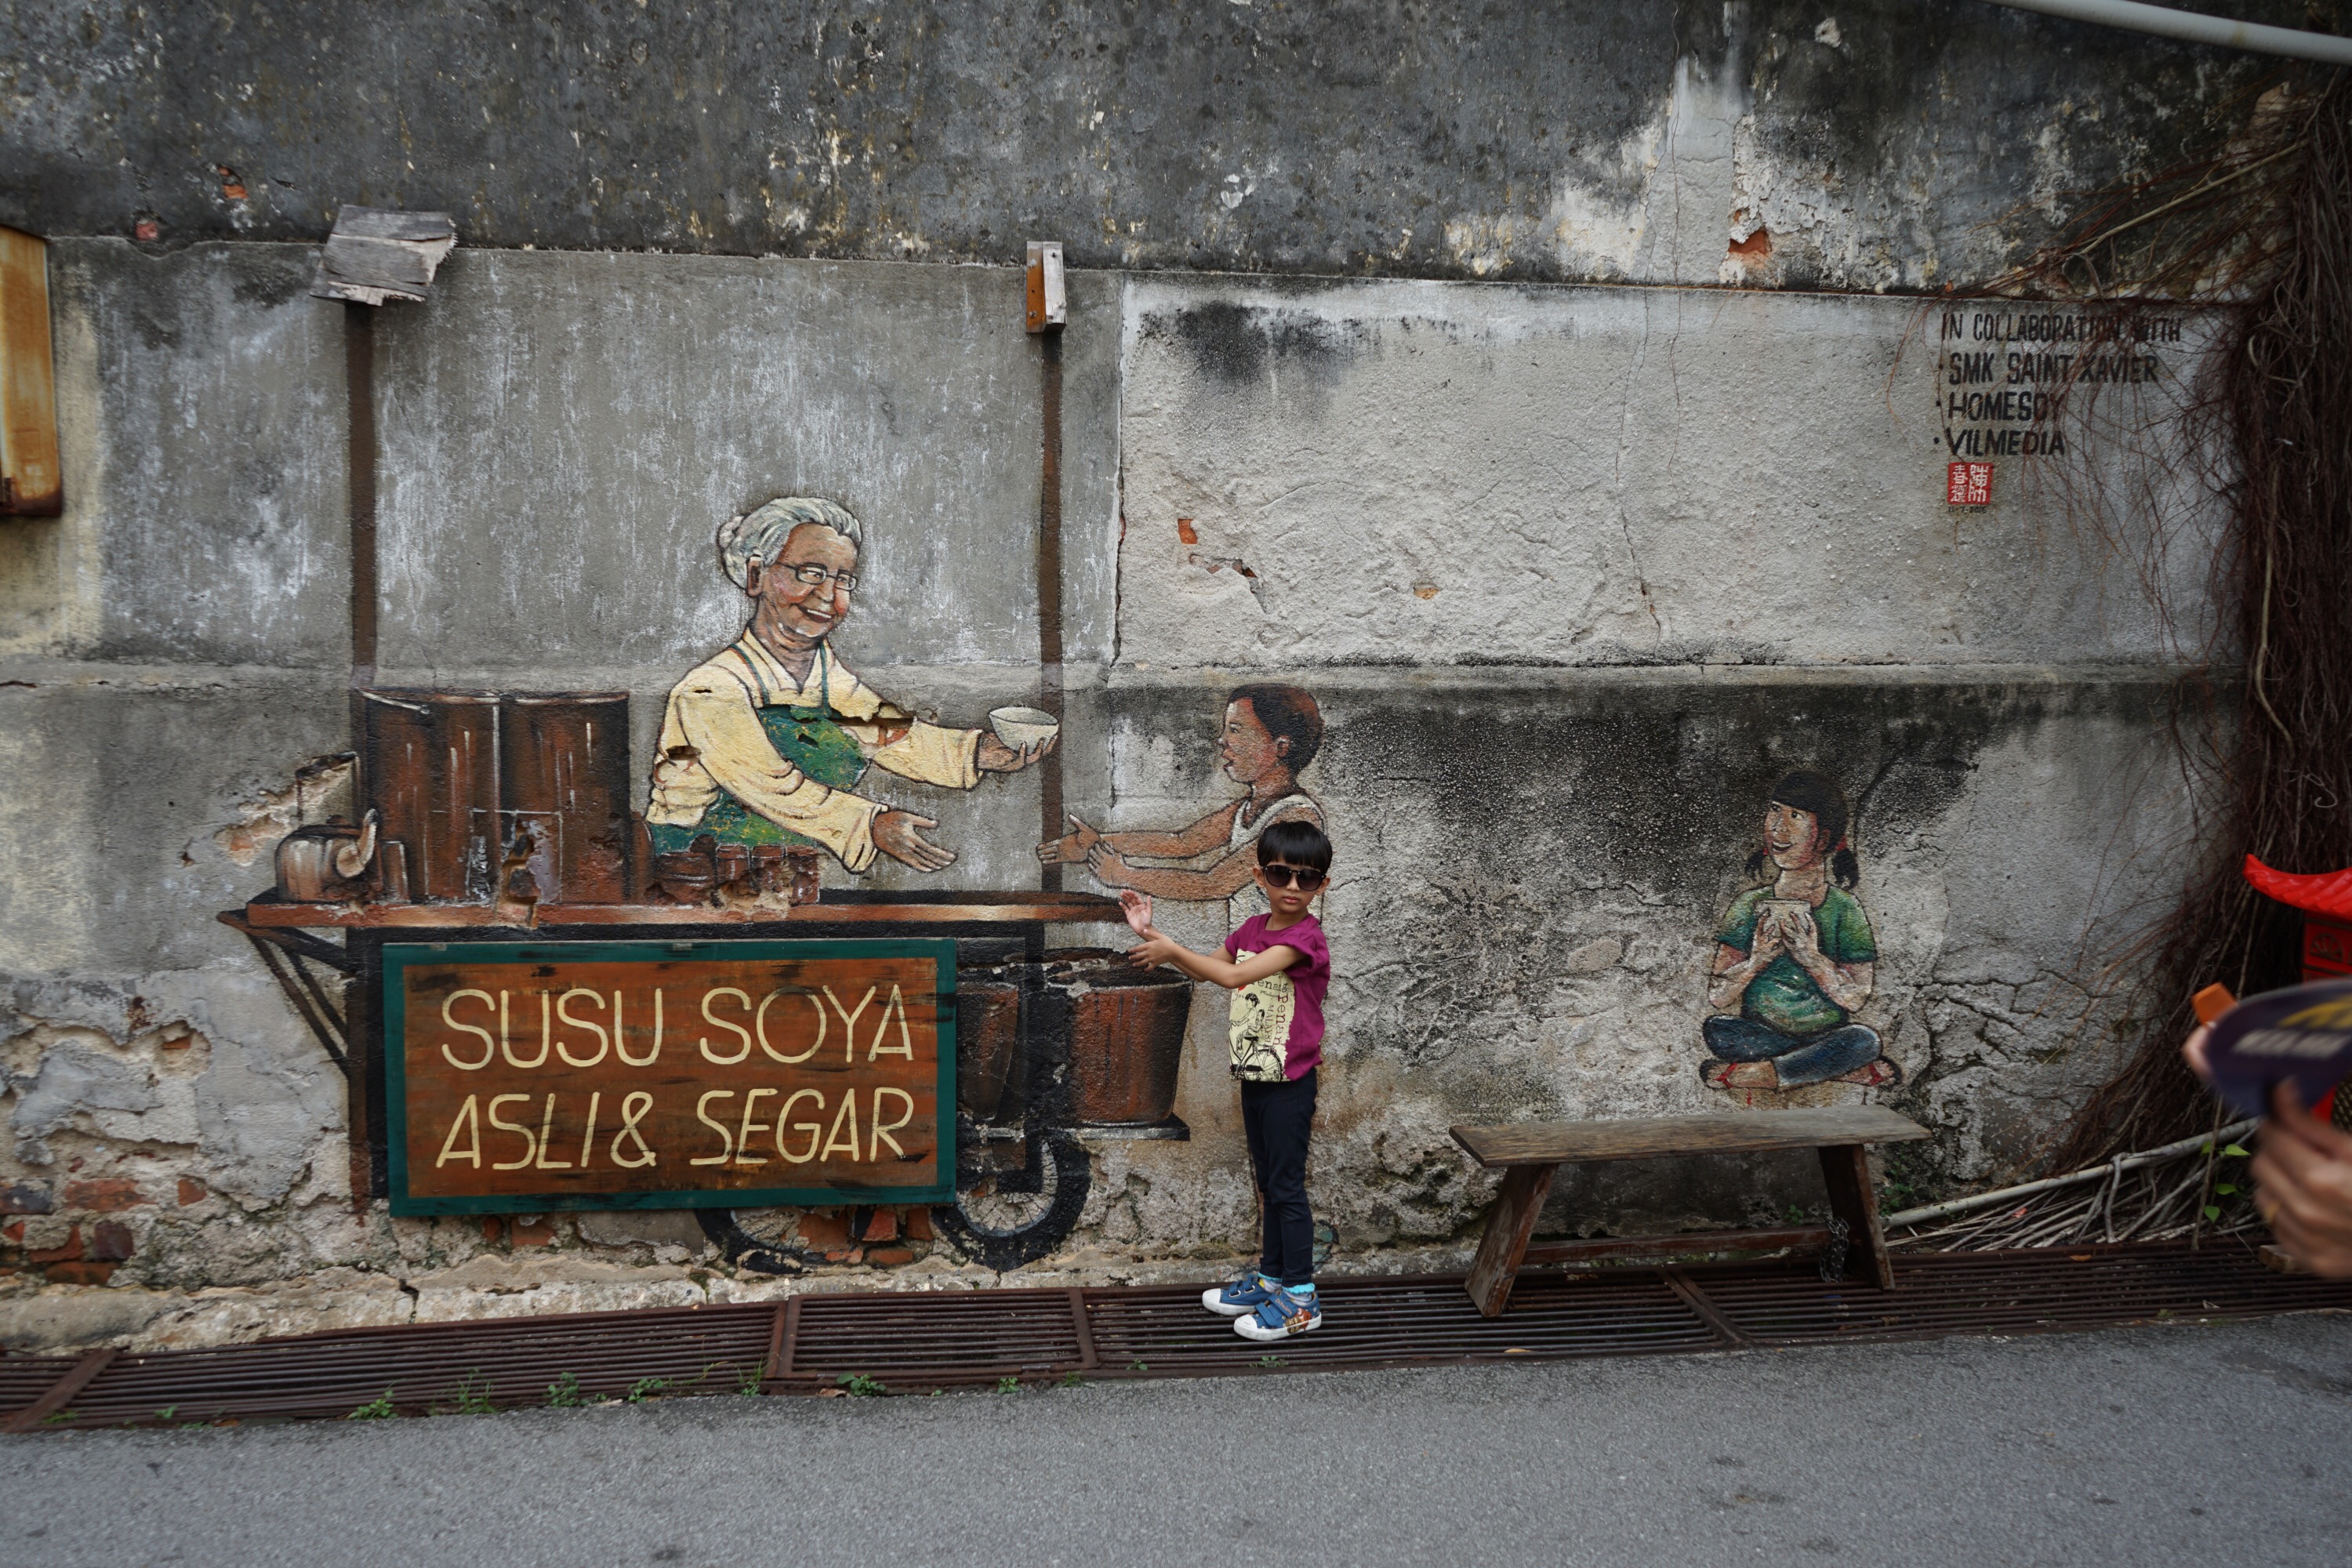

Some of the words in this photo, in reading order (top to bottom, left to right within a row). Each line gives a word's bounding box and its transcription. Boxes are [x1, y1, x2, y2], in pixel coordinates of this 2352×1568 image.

[1942, 313, 1963, 340] IN
[1973, 314, 2121, 342] COLLABORATION
[1949, 352, 1994, 385] SMK
[2008, 353, 2074, 384] SAINT
[2078, 355, 2158, 383] XAVIER
[1948, 391, 2066, 421] HOMESOY
[1946, 427, 2065, 456] VILMEDIA
[441, 988, 663, 1069] SUSU
[699, 984, 913, 1065] SOYA
[690, 1087, 914, 1164] SEGAR
